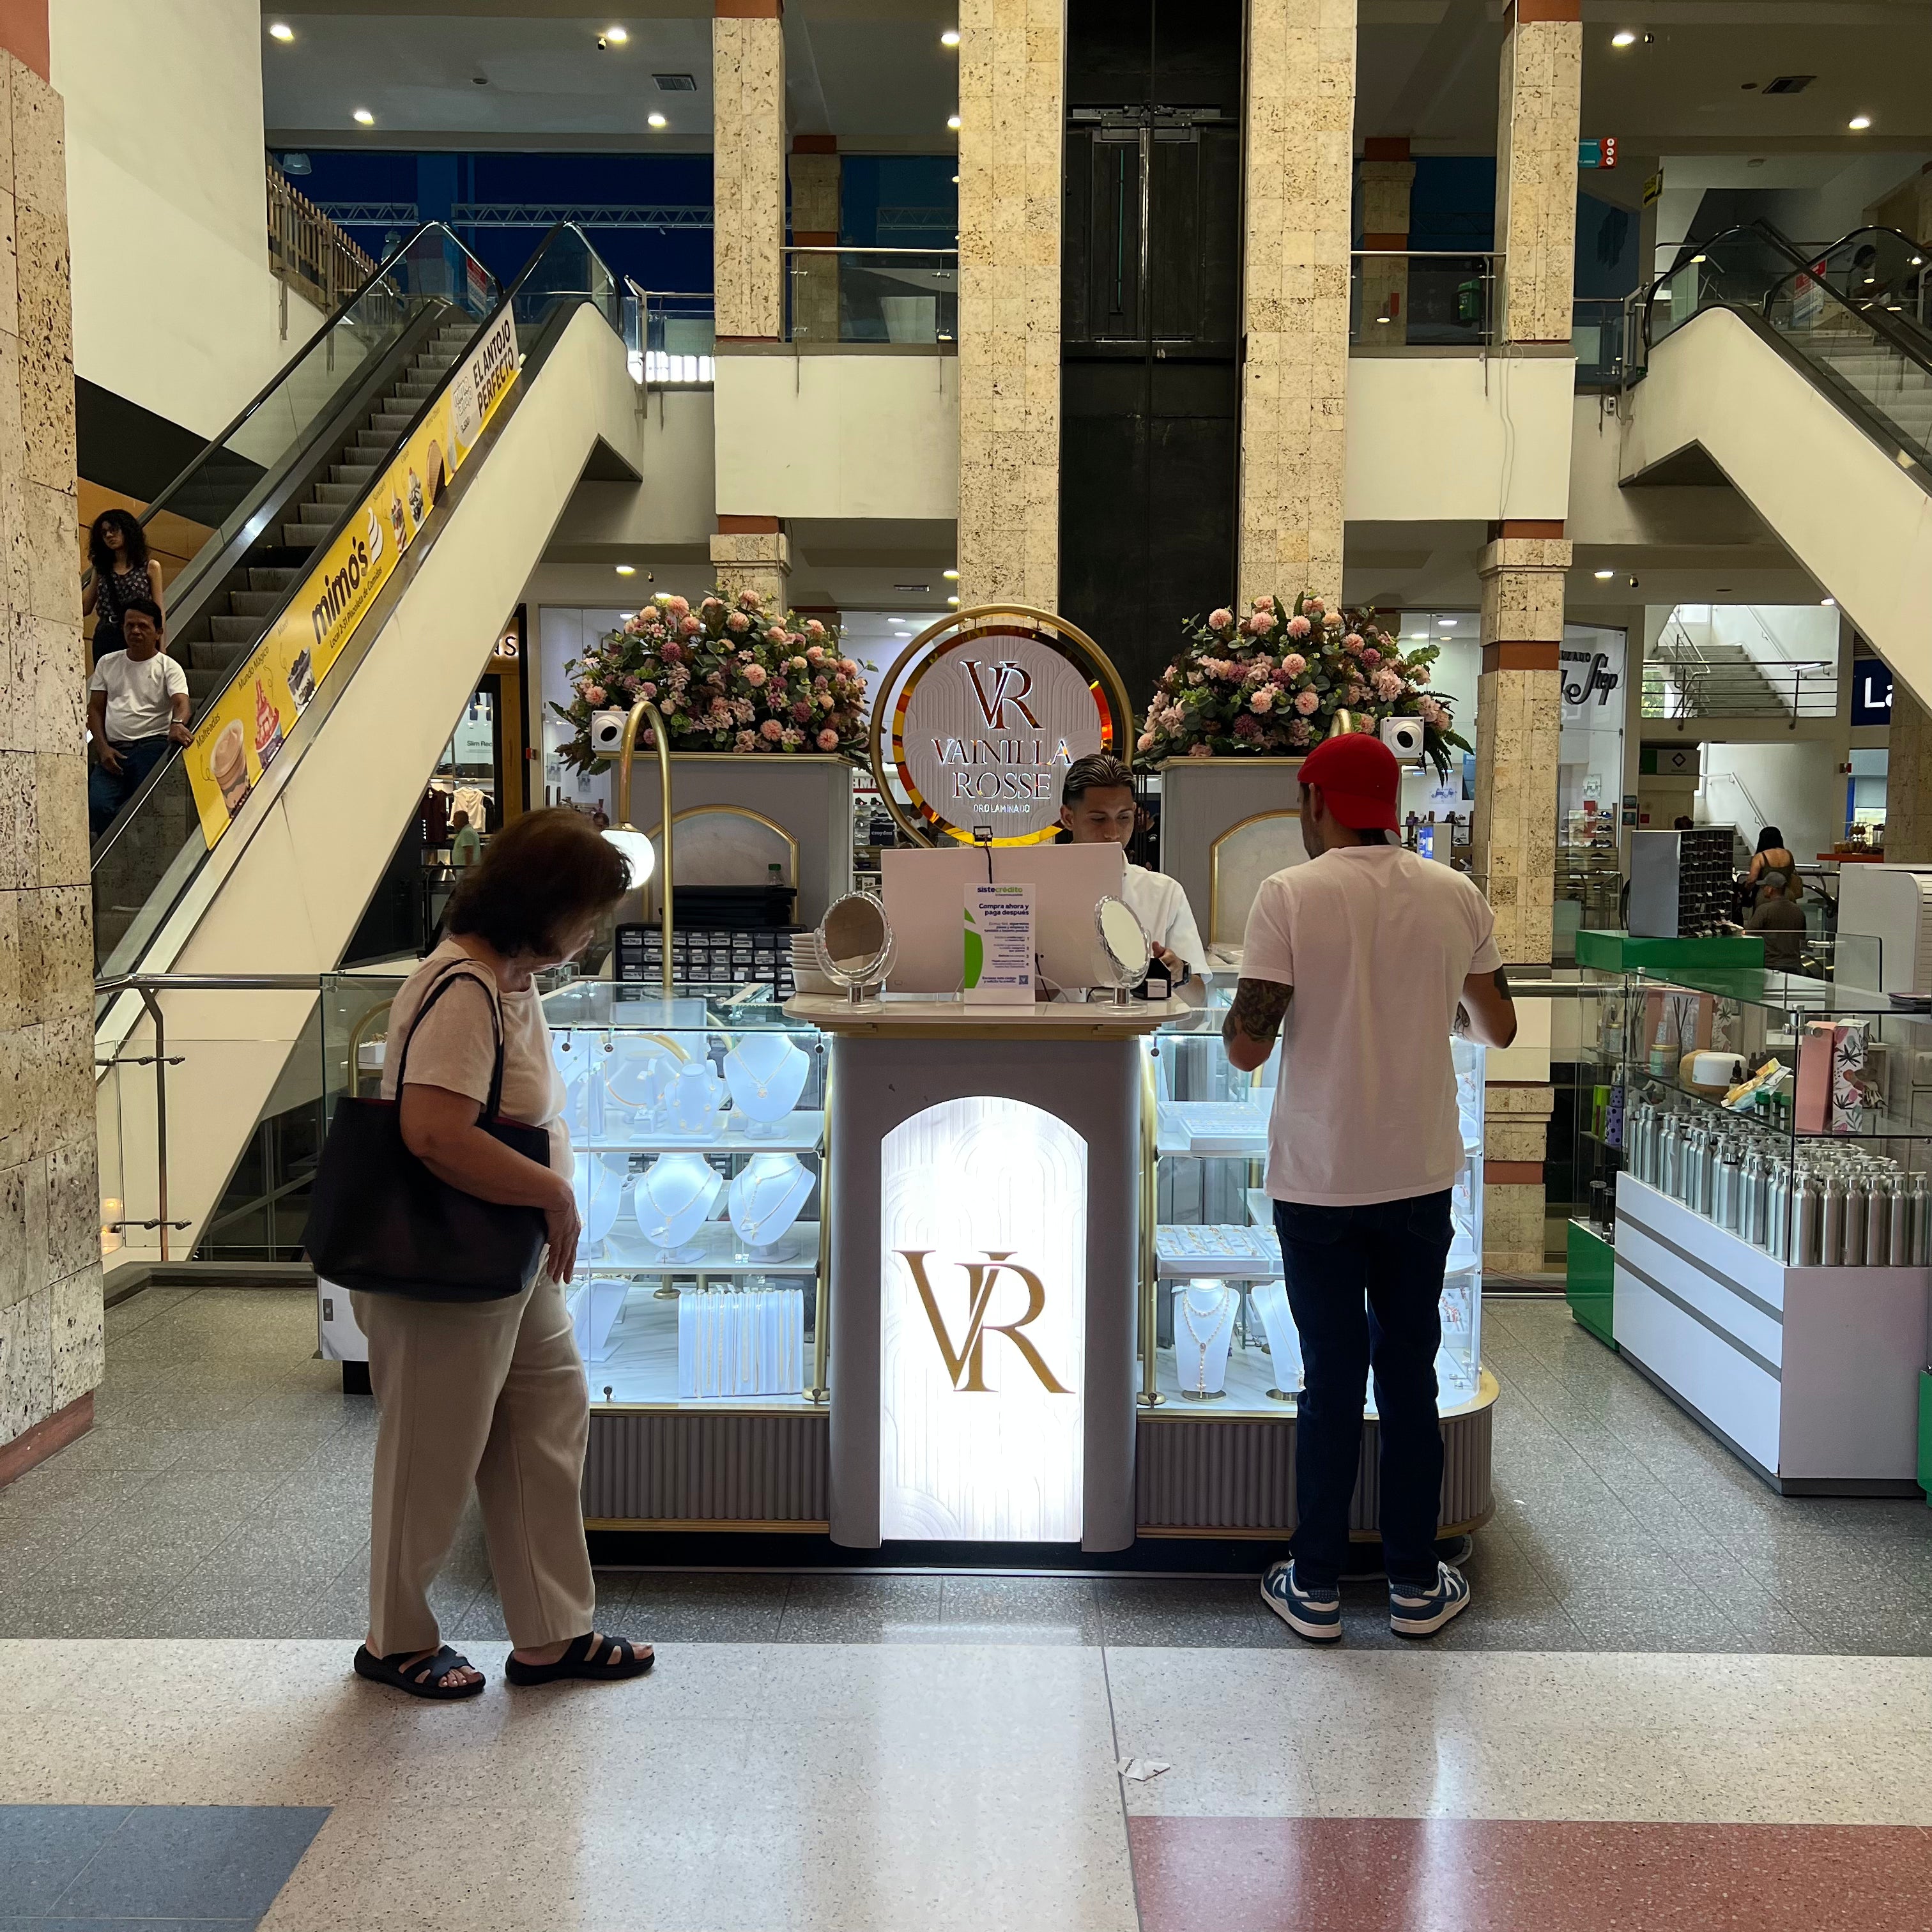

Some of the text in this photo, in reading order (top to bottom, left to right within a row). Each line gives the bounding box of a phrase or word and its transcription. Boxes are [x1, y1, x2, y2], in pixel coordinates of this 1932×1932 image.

[473, 319, 510, 388] EL ANTOJO
[477, 346, 514, 418] PERFECTO
[330, 627, 340, 648] Local
[238, 666, 254, 691] Mundo
[959, 660, 1045, 730] VR
[195, 712, 220, 749] Malteadas
[931, 739, 1075, 766] VAINILLA
[952, 771, 1052, 799] ROSSE
[973, 804, 990, 813] ORO
[891, 1249, 1076, 1394] VR
